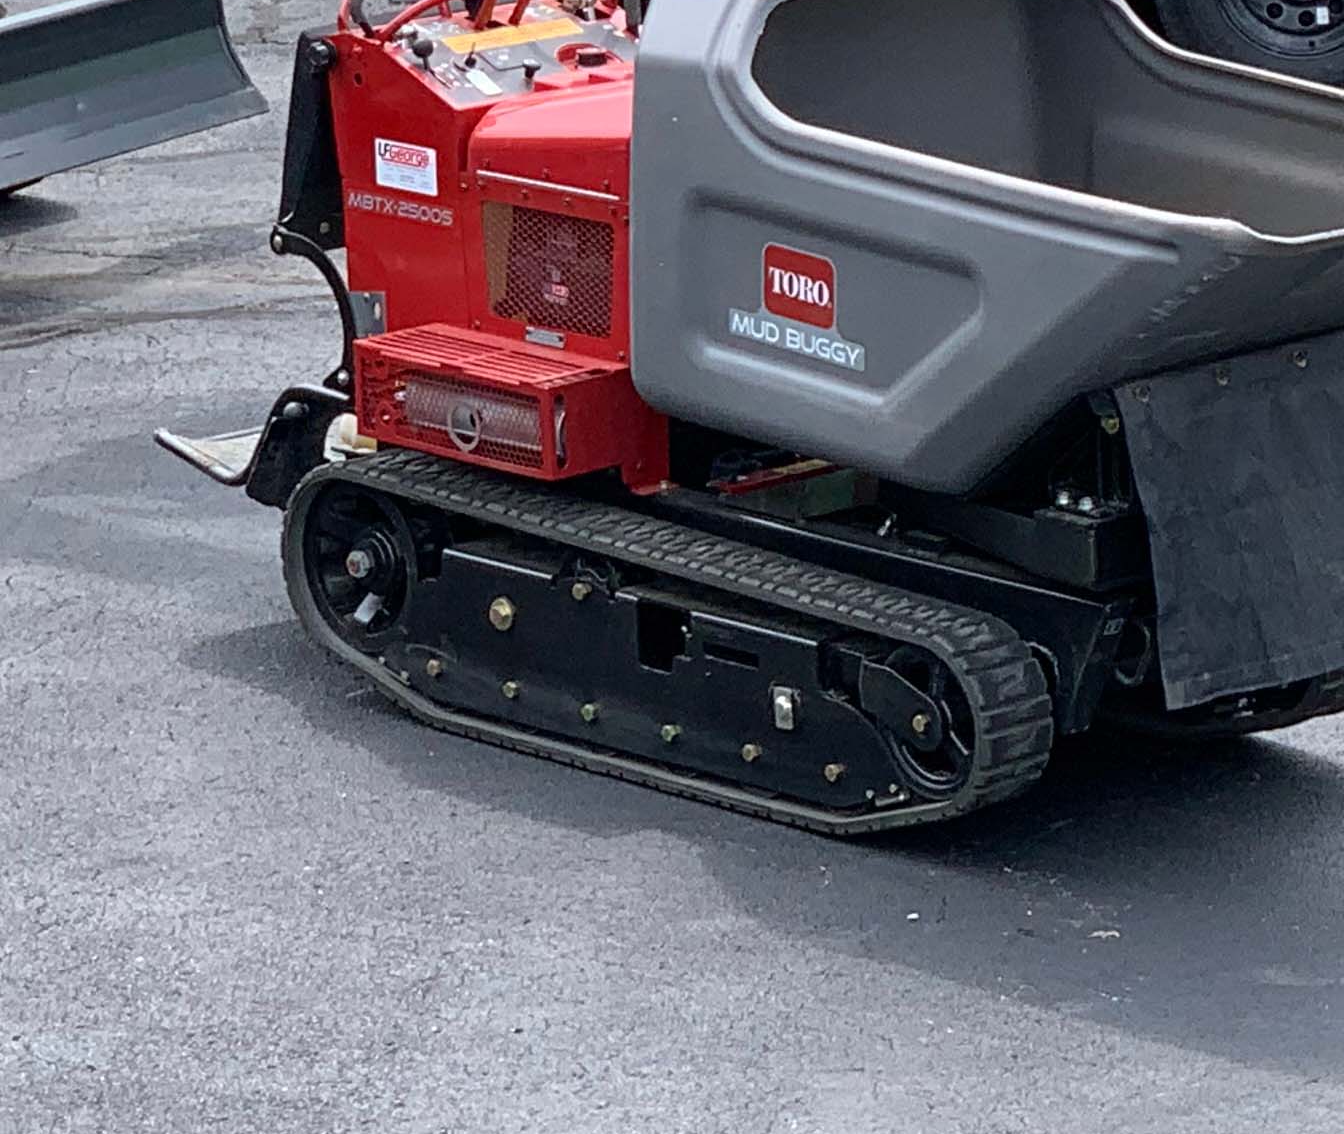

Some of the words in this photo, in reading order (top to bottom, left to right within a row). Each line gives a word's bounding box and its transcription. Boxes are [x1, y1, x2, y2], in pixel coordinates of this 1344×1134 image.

[768, 267, 830, 307] TORO
[732, 313, 780, 343] MUD
[785, 328, 861, 366] BUGGY
